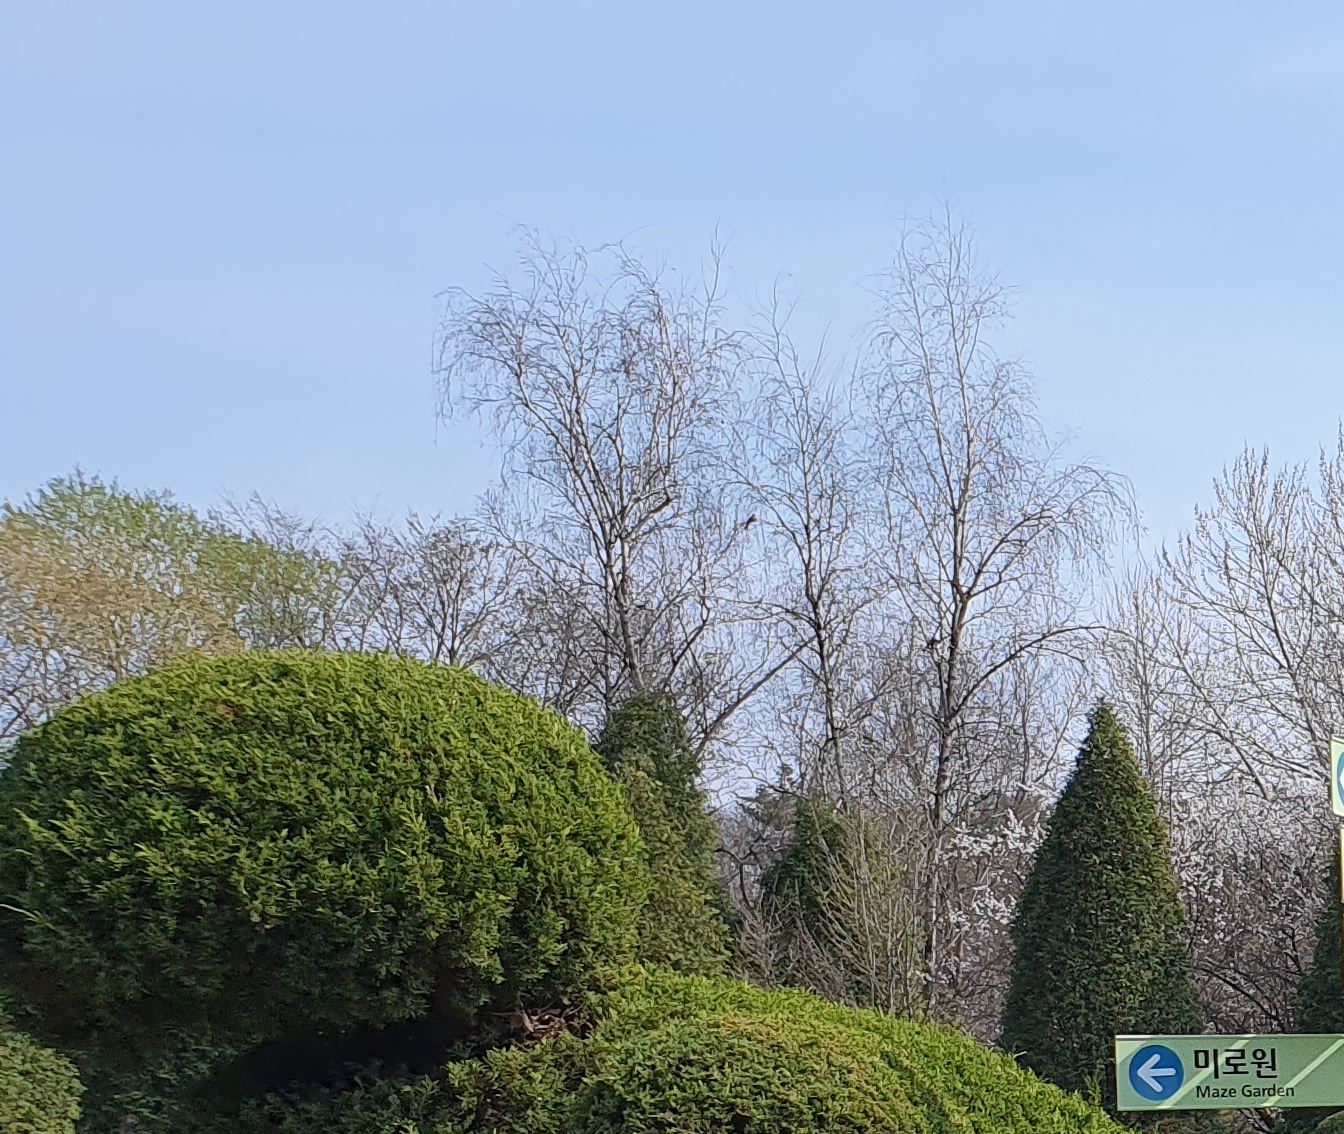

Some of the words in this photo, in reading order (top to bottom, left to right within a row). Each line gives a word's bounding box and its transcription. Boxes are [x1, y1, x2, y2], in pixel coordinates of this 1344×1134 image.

[1193, 1047, 1278, 1079] 미로원
[1195, 1084, 1238, 1099] Maze
[1241, 1082, 1295, 1098] Garden
